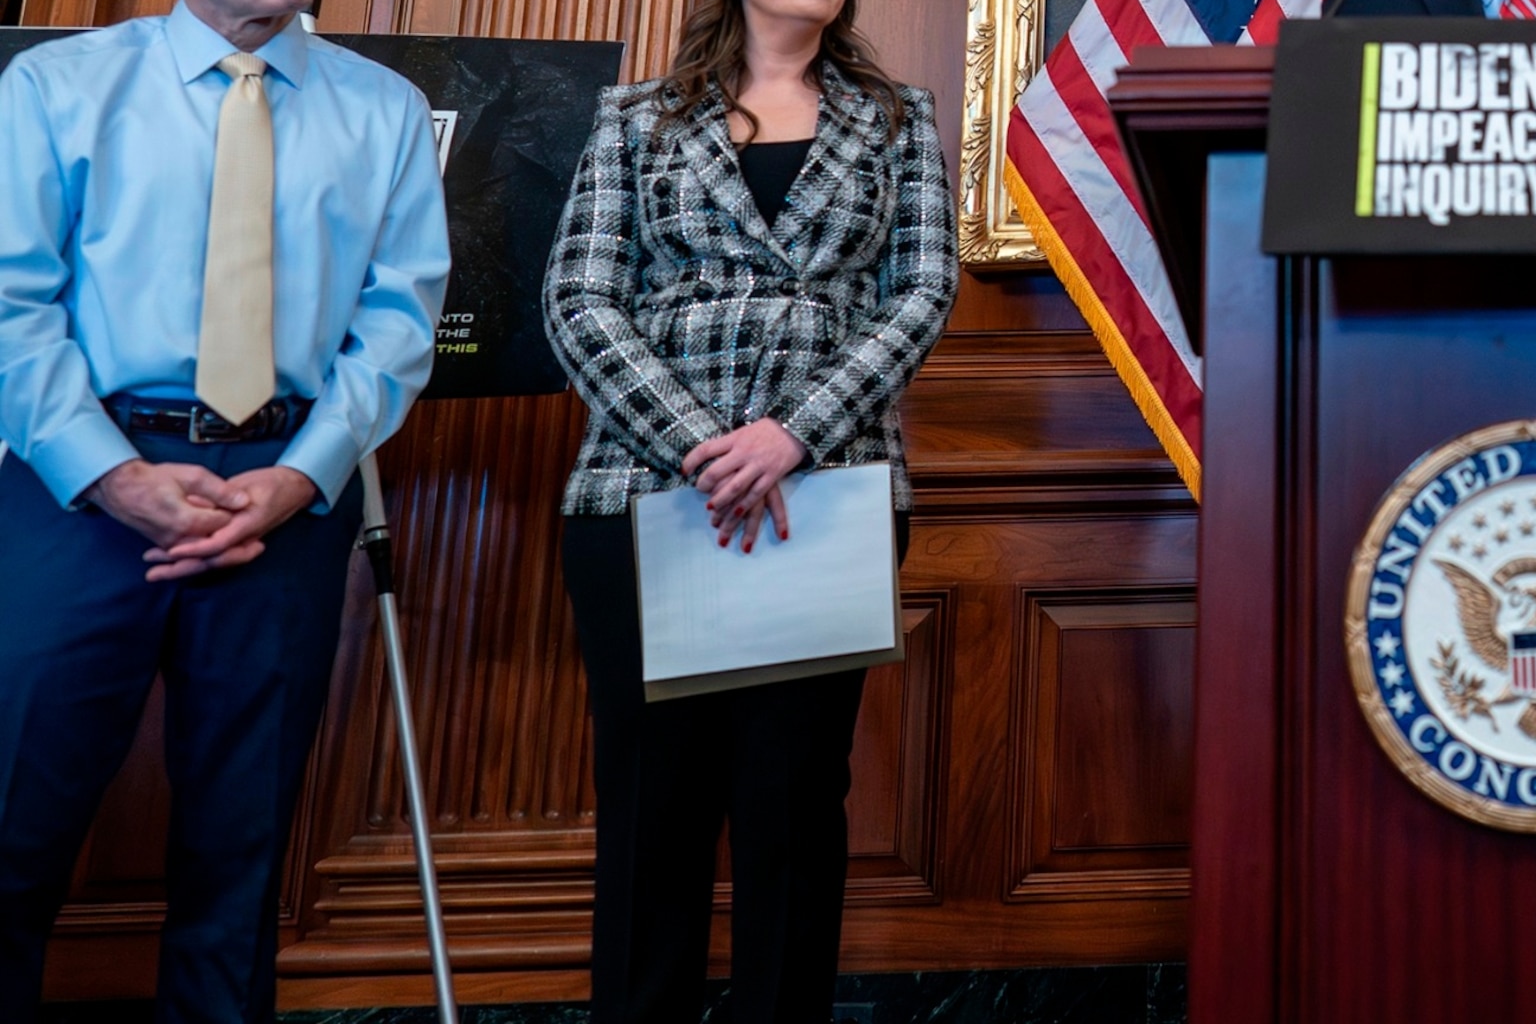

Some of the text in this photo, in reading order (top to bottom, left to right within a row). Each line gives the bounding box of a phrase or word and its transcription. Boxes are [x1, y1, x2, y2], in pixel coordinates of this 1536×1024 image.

[436, 328, 470, 338] THE
[436, 343, 478, 353] THIS
[1368, 444, 1521, 620] UNITED
